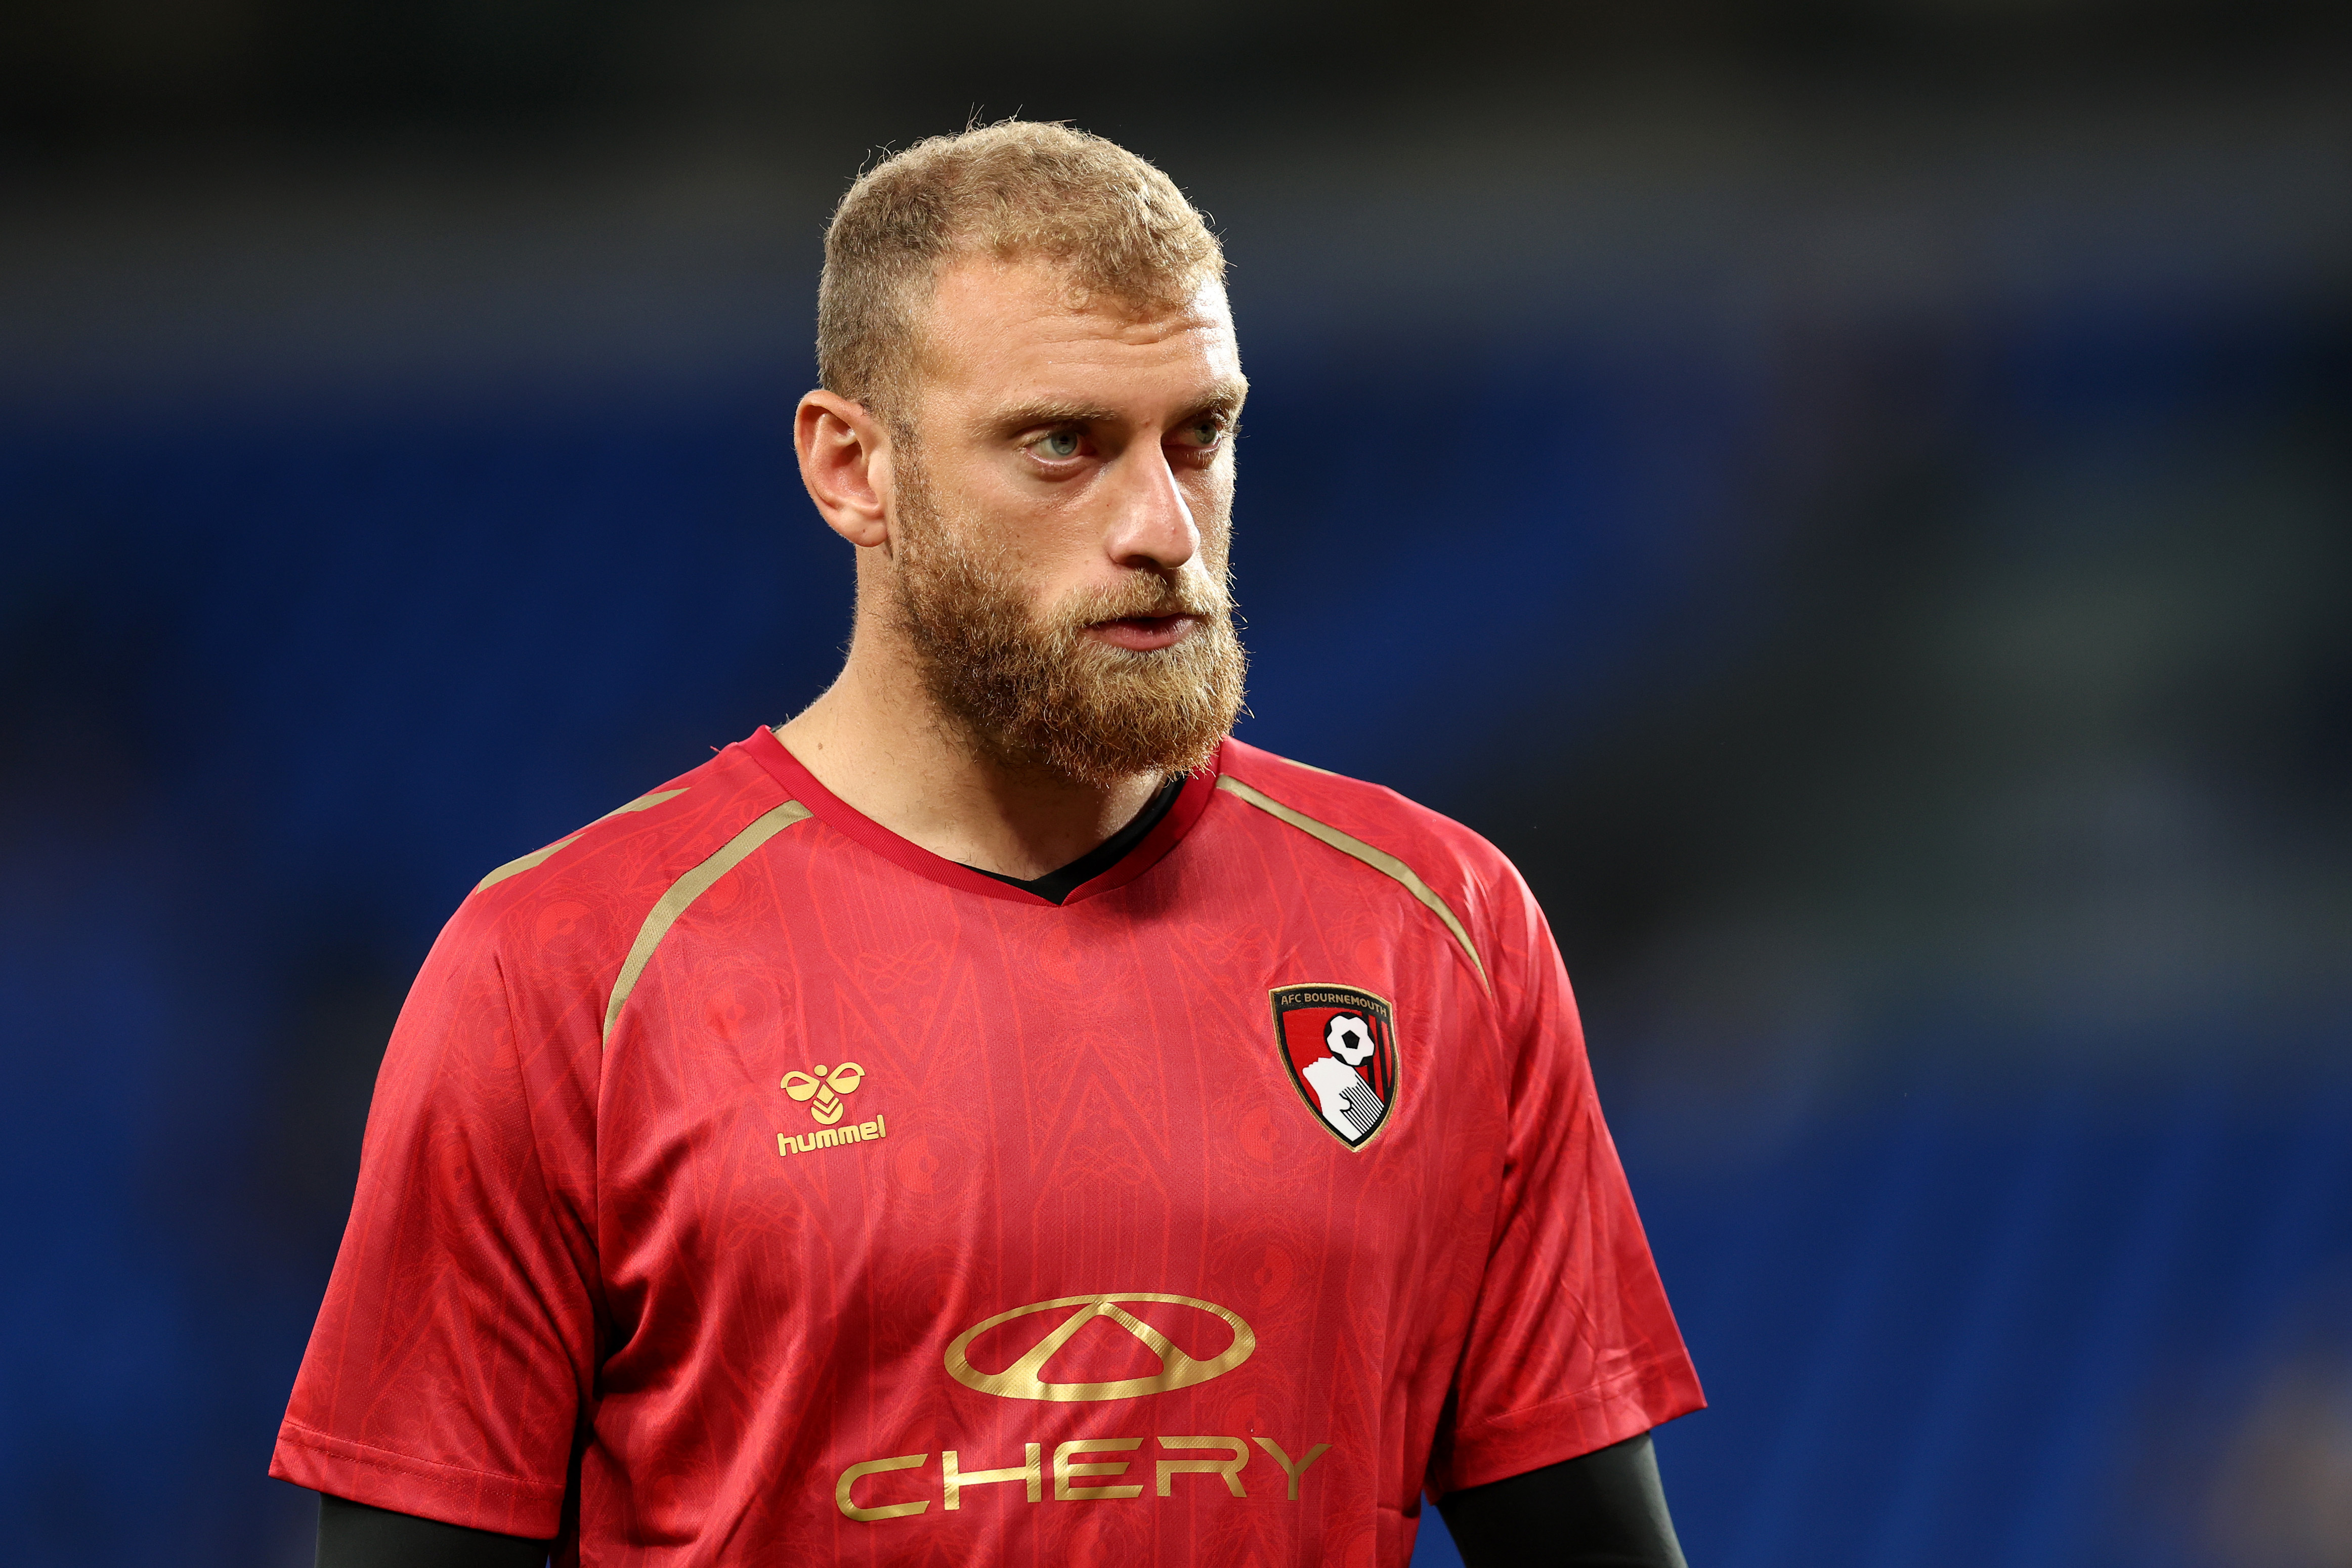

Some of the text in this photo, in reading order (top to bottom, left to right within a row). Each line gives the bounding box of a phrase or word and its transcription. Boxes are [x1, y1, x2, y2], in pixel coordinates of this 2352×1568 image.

[1281, 992, 1388, 1018] AFC BOURNEMOUTH
[777, 1114, 886, 1157] hummel
[835, 1436, 1333, 1522] CHERY
